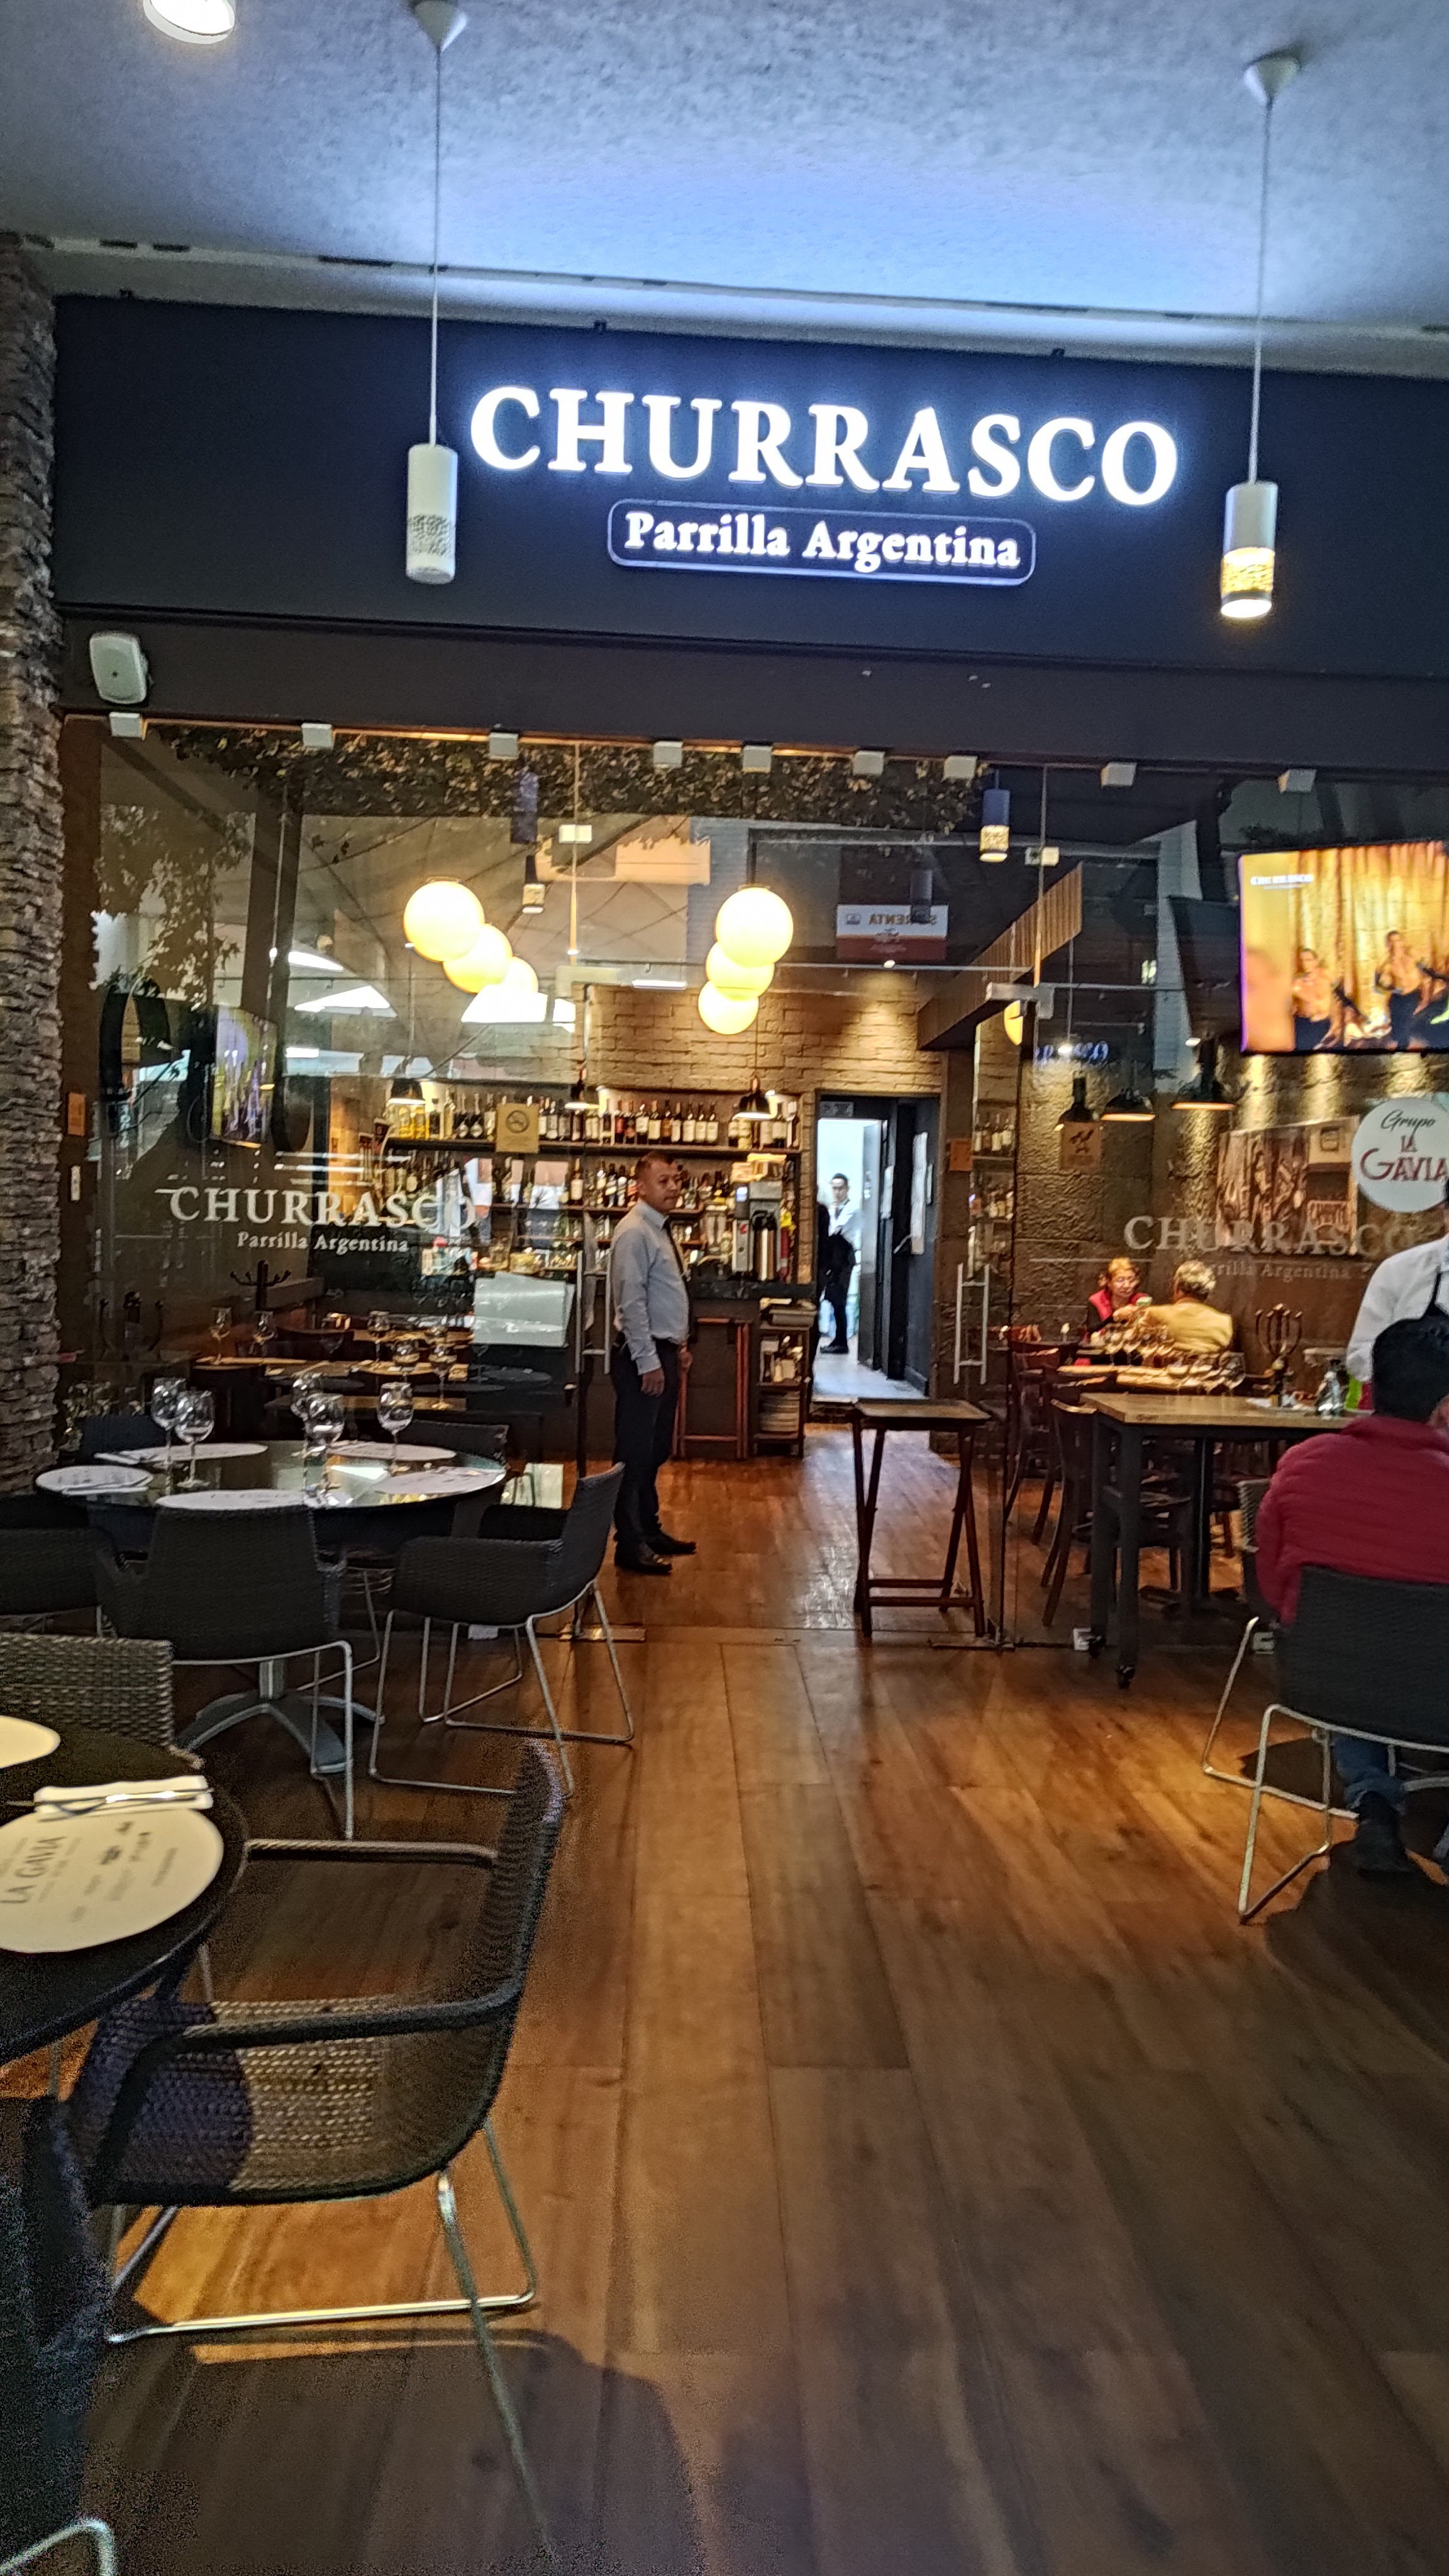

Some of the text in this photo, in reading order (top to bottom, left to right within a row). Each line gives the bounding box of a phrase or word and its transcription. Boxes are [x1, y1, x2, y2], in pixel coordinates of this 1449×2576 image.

[470, 386, 1177, 506] CHURRASCO
[625, 511, 1021, 573] Parrilla Argentina
[1380, 1109, 1436, 1136] Grupo
[170, 1186, 476, 1231] CHURRASCO
[237, 1231, 409, 1255] Parrilla Argentina
[1124, 1215, 1415, 1257] CHURRASCO
[1261, 1262, 1351, 1283] Argentina
